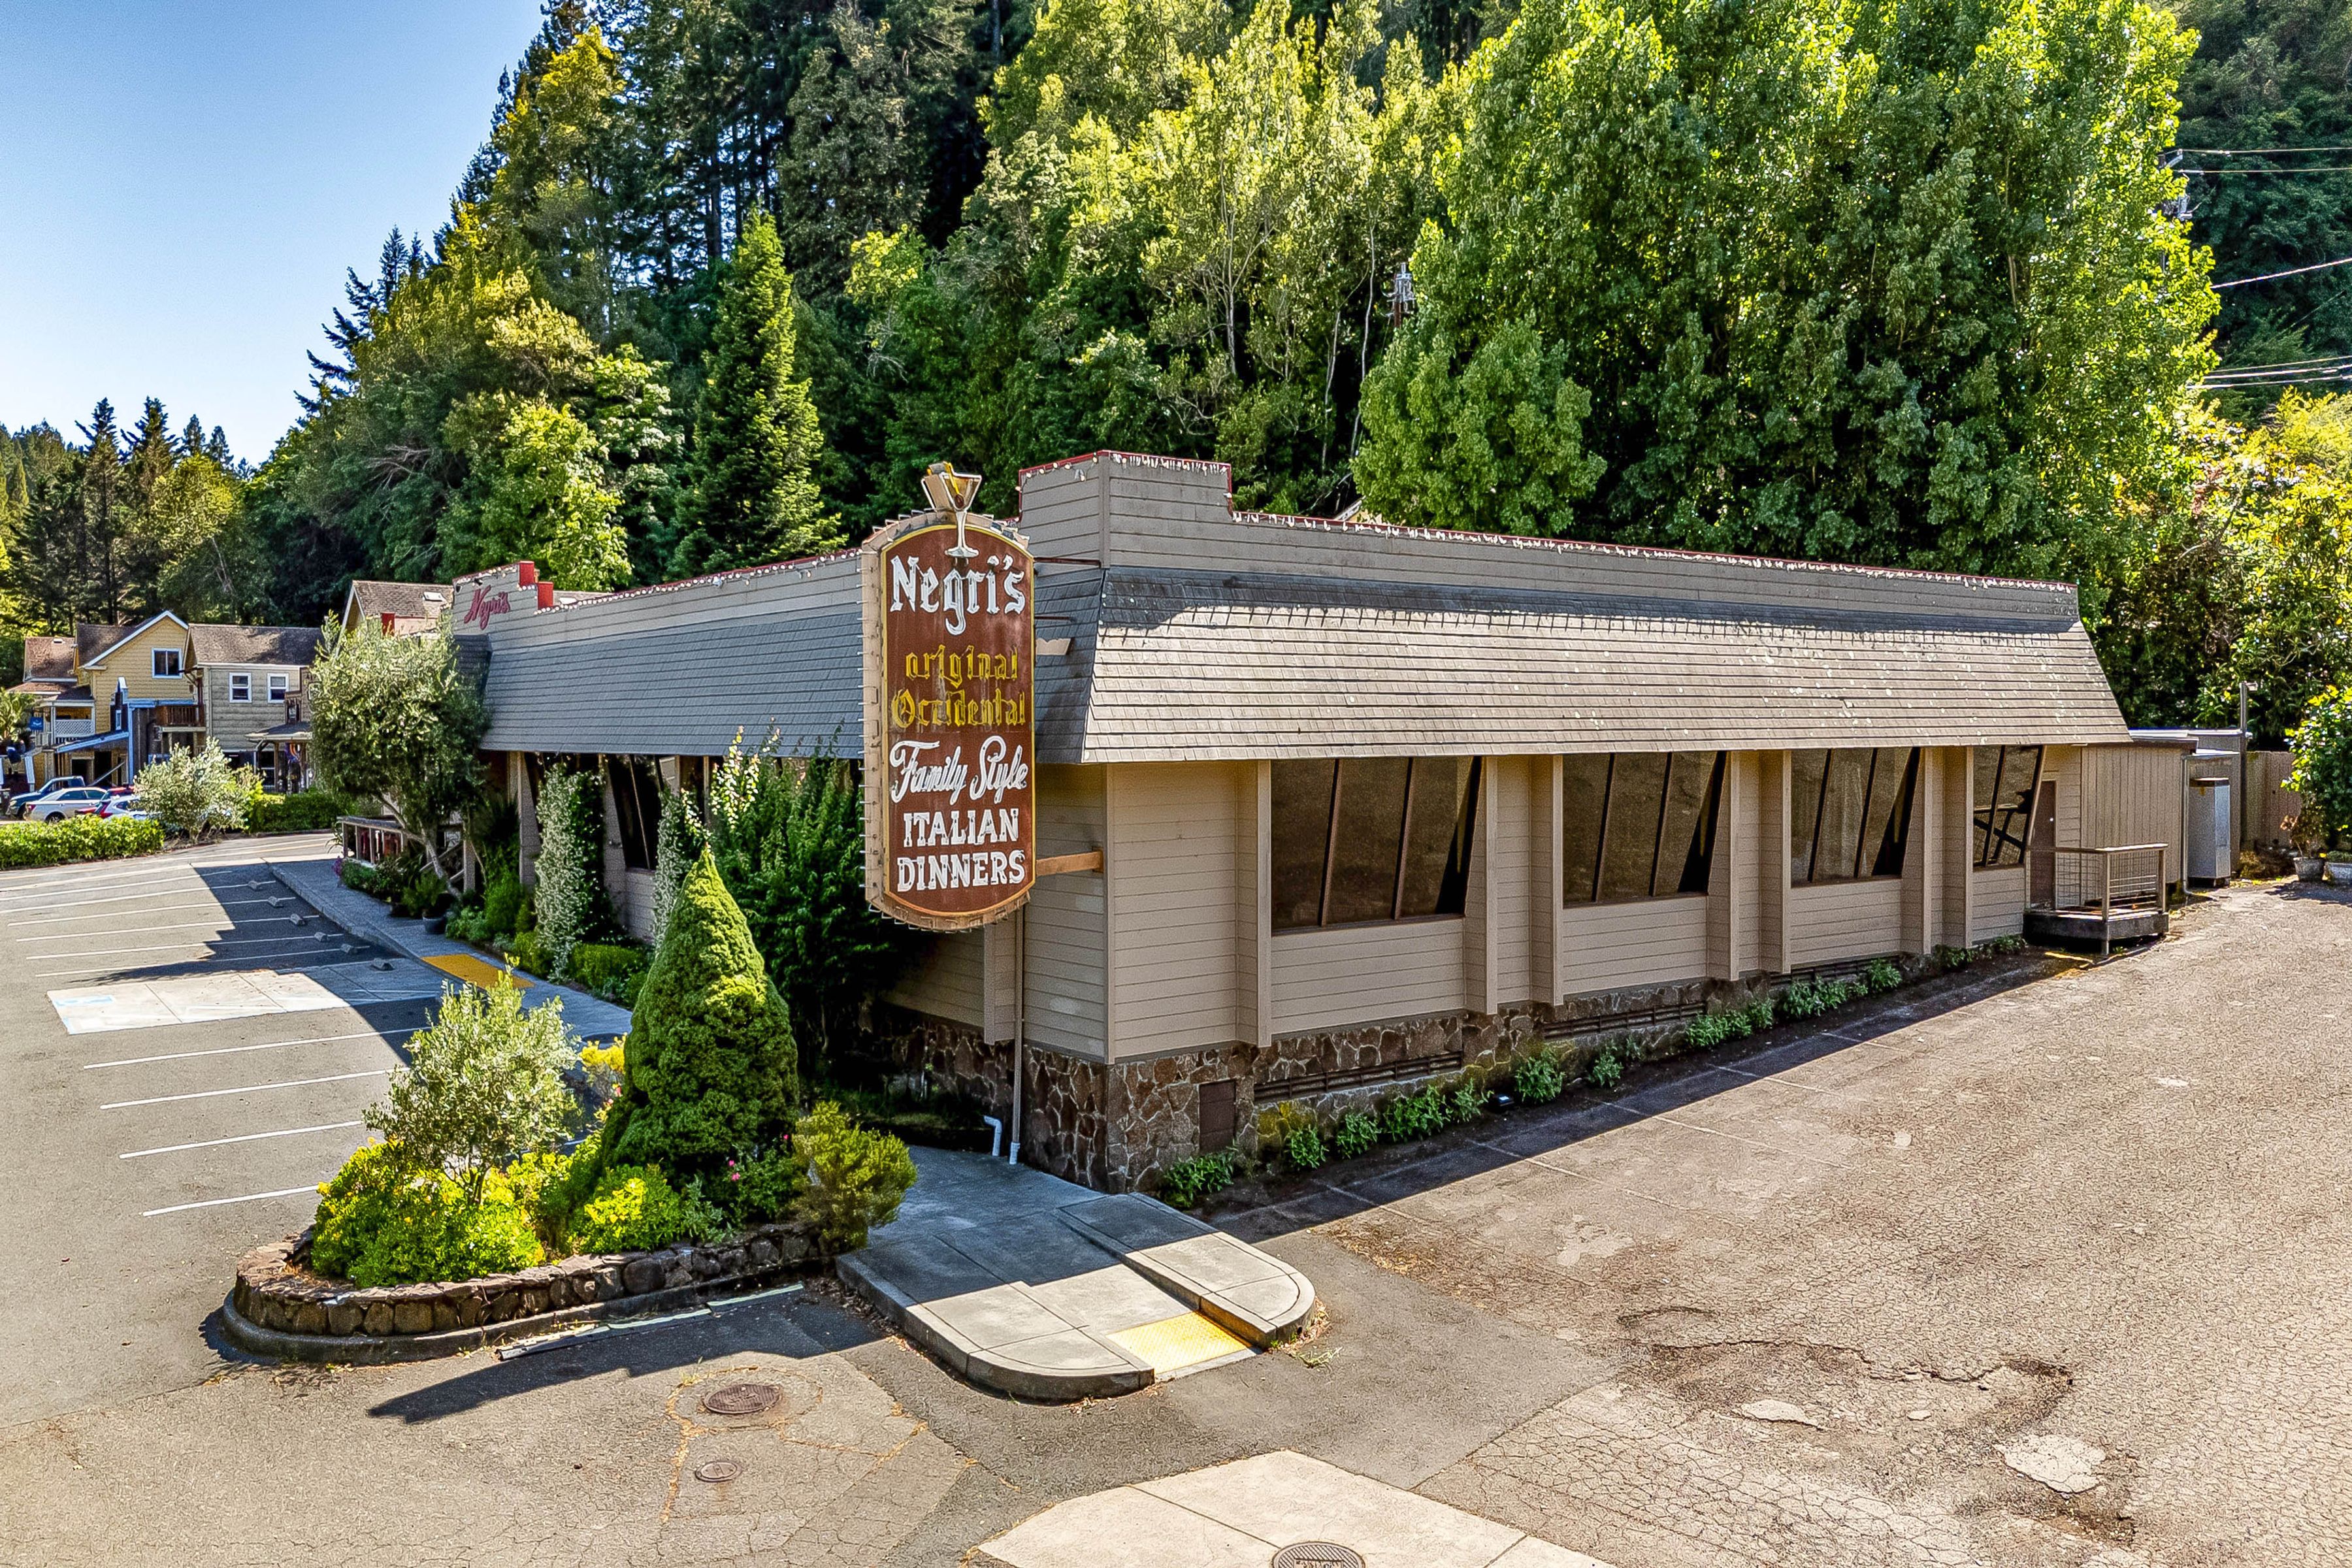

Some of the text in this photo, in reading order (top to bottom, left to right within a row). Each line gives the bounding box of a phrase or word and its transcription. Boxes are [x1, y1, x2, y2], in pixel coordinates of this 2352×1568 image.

[890, 555, 1026, 636] Negri's
[906, 644, 1018, 689] original
[891, 688, 1026, 728] Occidental
[889, 735, 1029, 805] Family Style
[904, 808, 1019, 847] ITALIAN
[897, 849, 1026, 892] DINNERS
